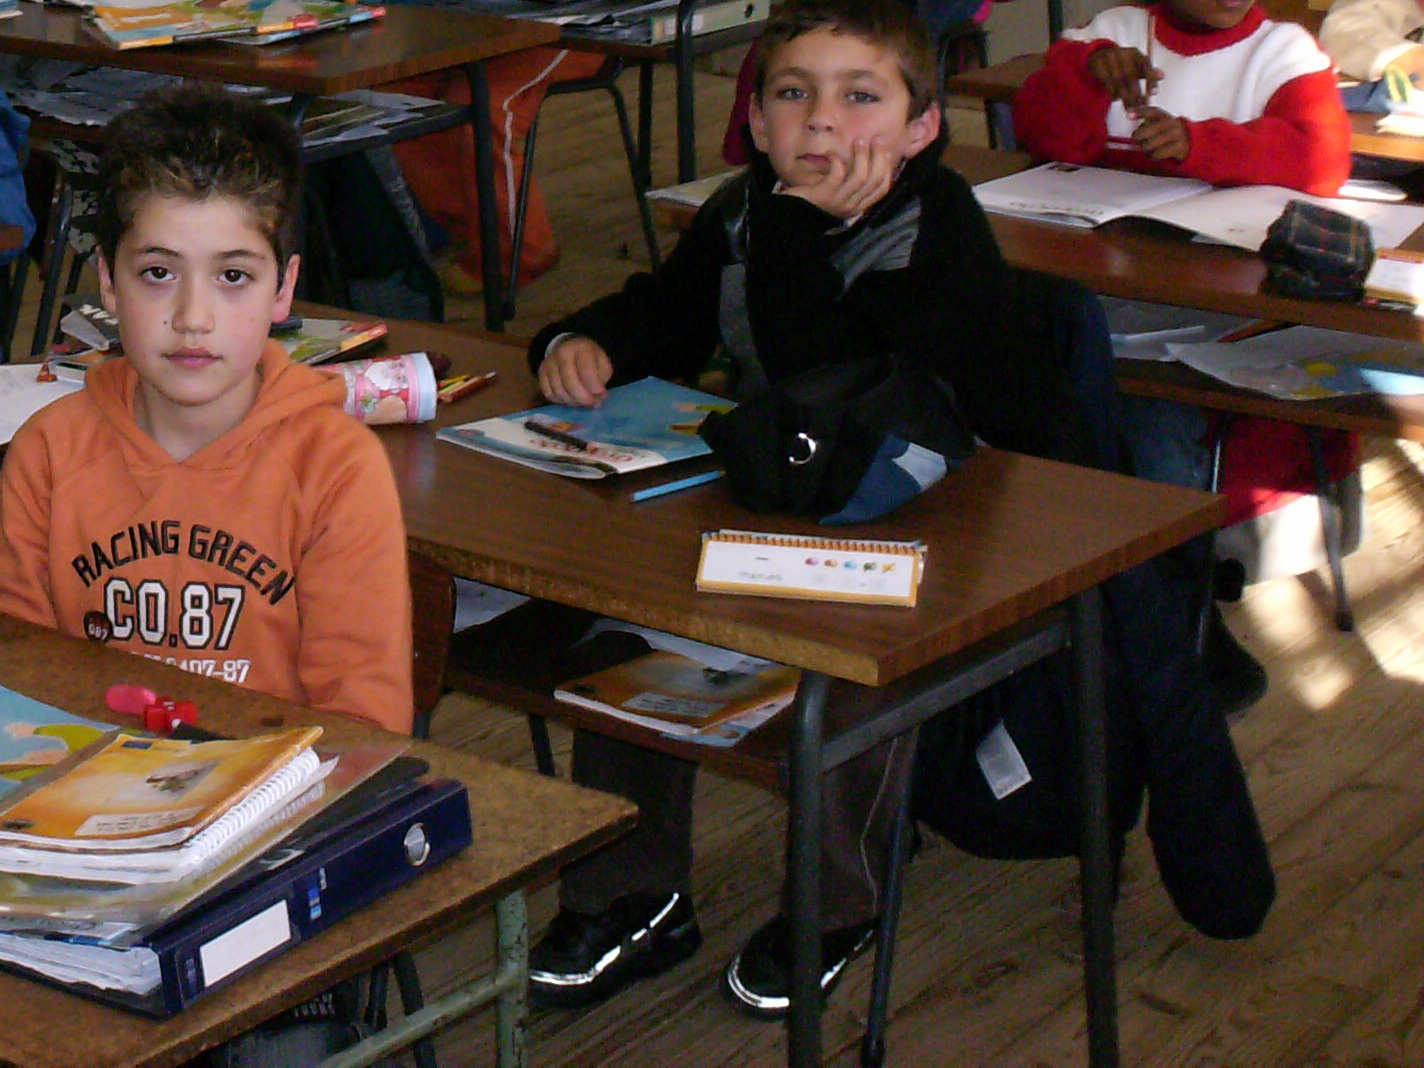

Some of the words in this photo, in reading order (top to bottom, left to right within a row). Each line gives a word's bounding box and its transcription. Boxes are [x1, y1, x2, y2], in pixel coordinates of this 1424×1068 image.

[71, 519, 181, 588] RACING
[187, 523, 297, 607] GREEN
[102, 576, 246, 651] CO.87
